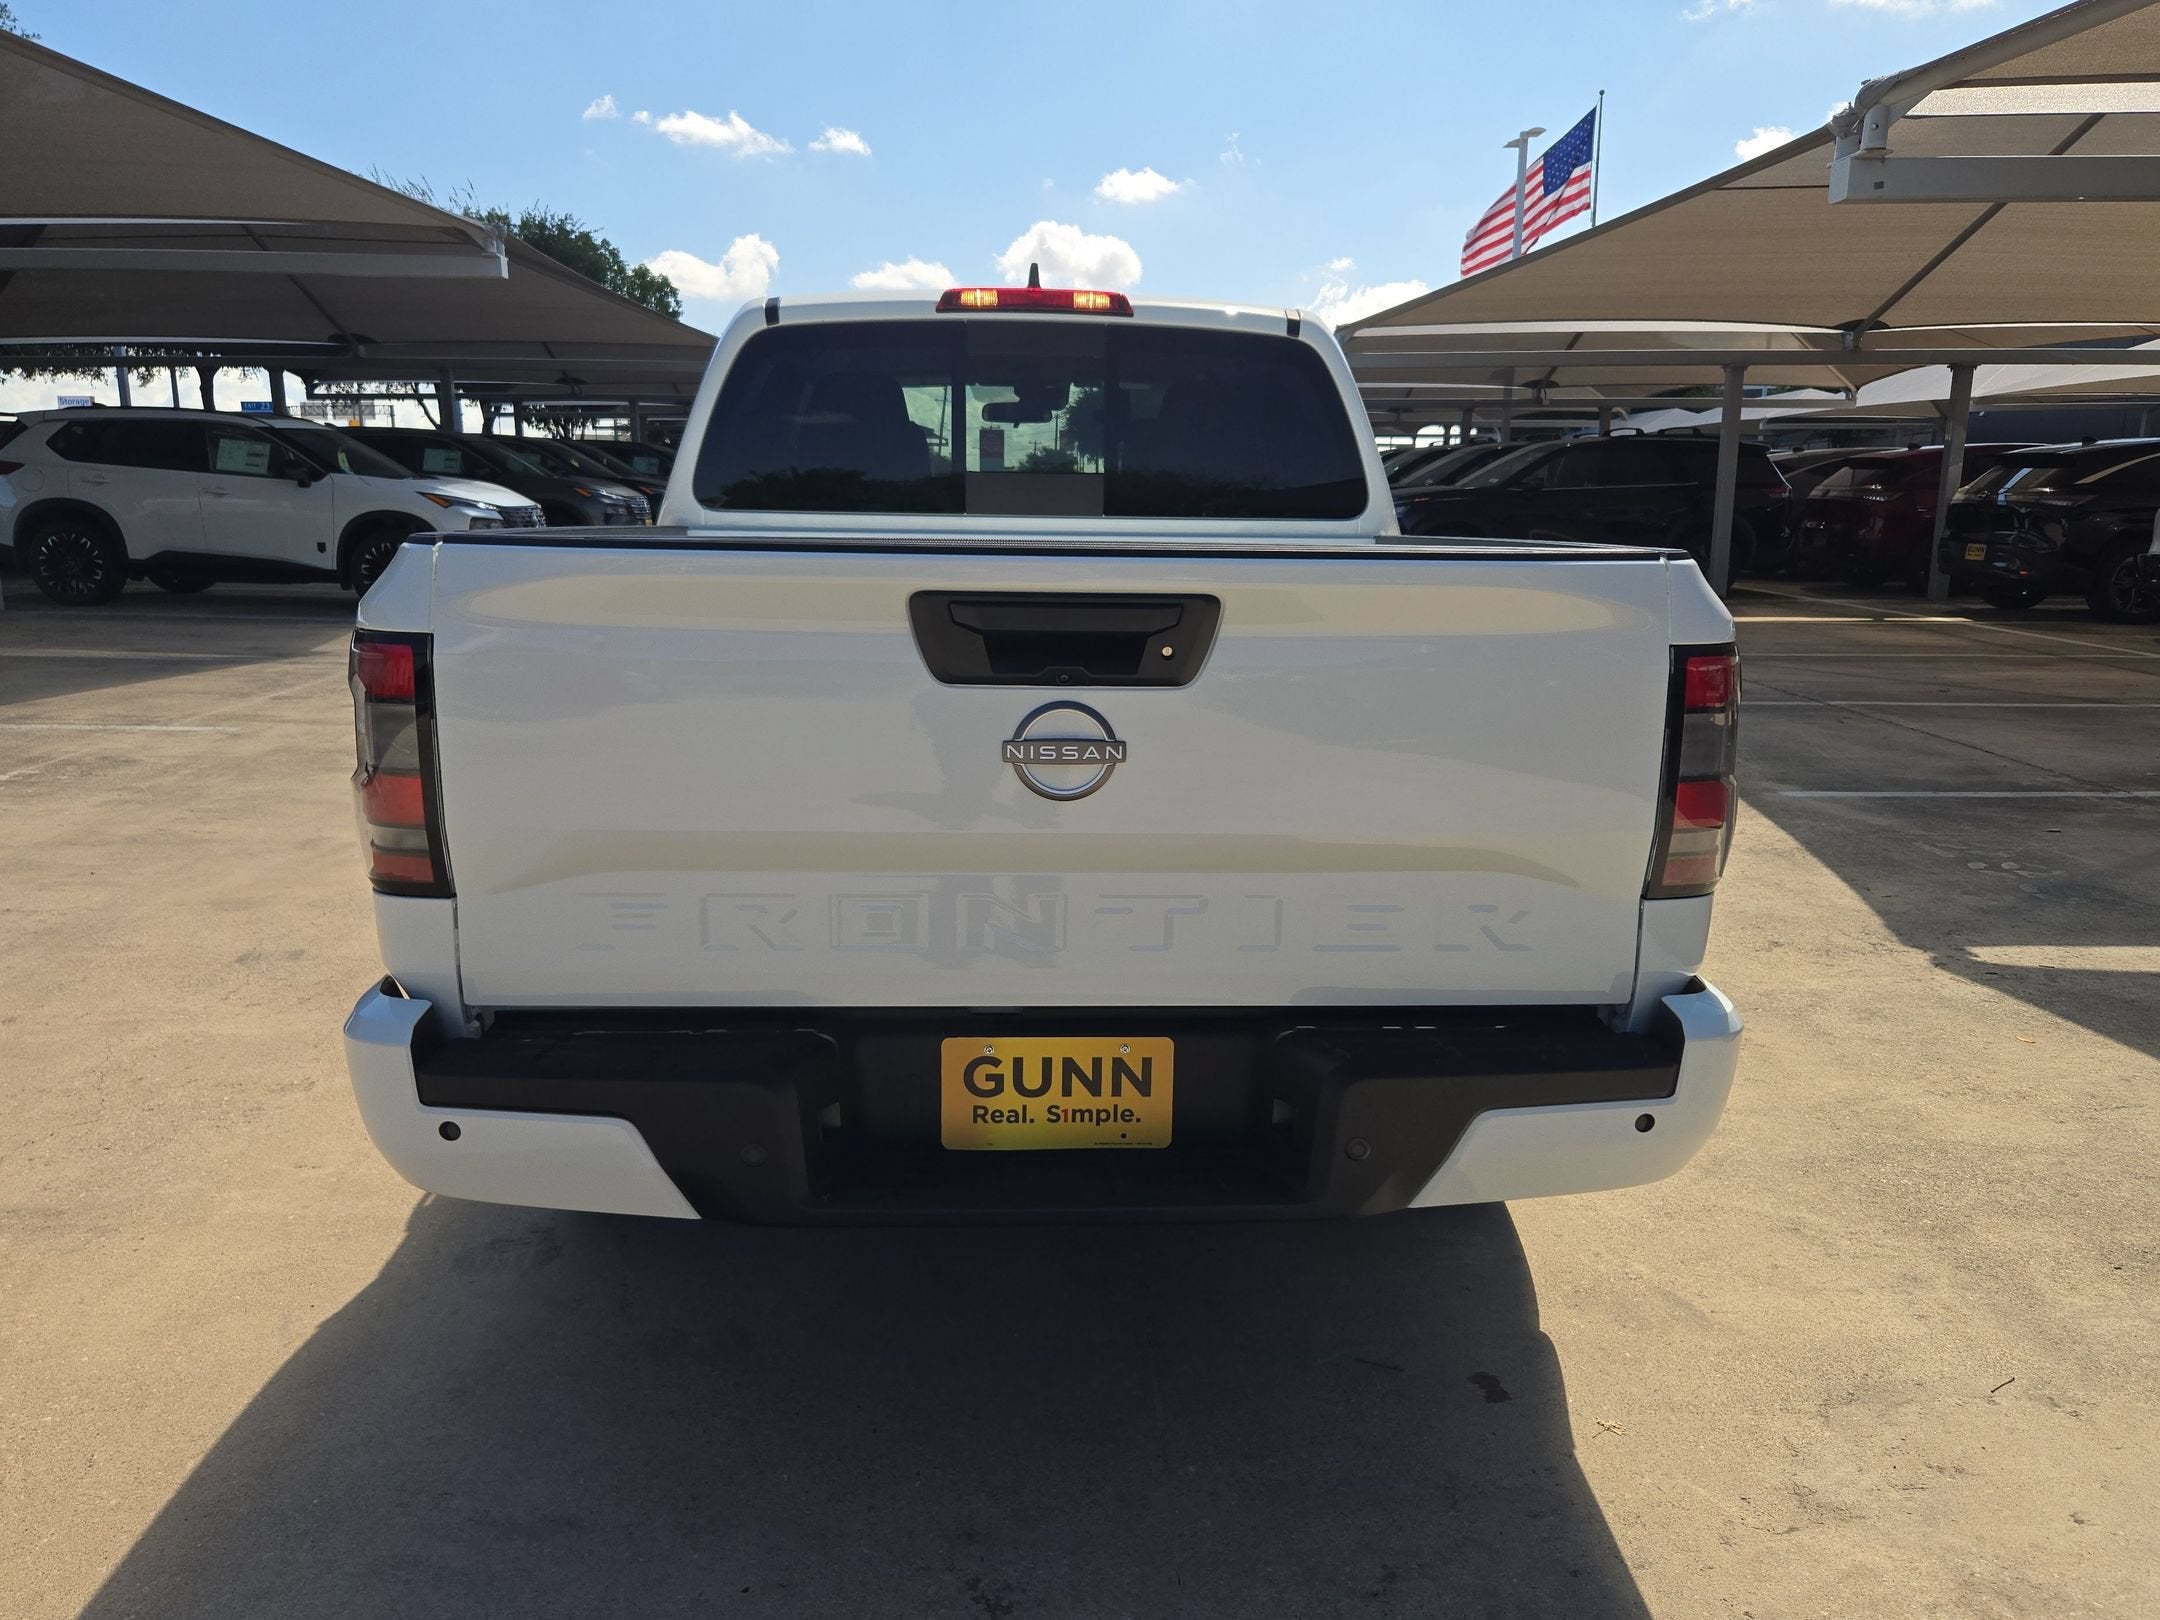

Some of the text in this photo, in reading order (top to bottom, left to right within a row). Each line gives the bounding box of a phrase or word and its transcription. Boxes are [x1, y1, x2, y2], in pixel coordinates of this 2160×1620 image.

[59, 397, 90, 407] Storage
[1007, 745, 1122, 760] NISSAN
[576, 888, 1533, 952] FRONTIER
[962, 1055, 1153, 1098] GUNN
[972, 1104, 1035, 1124] Real.
